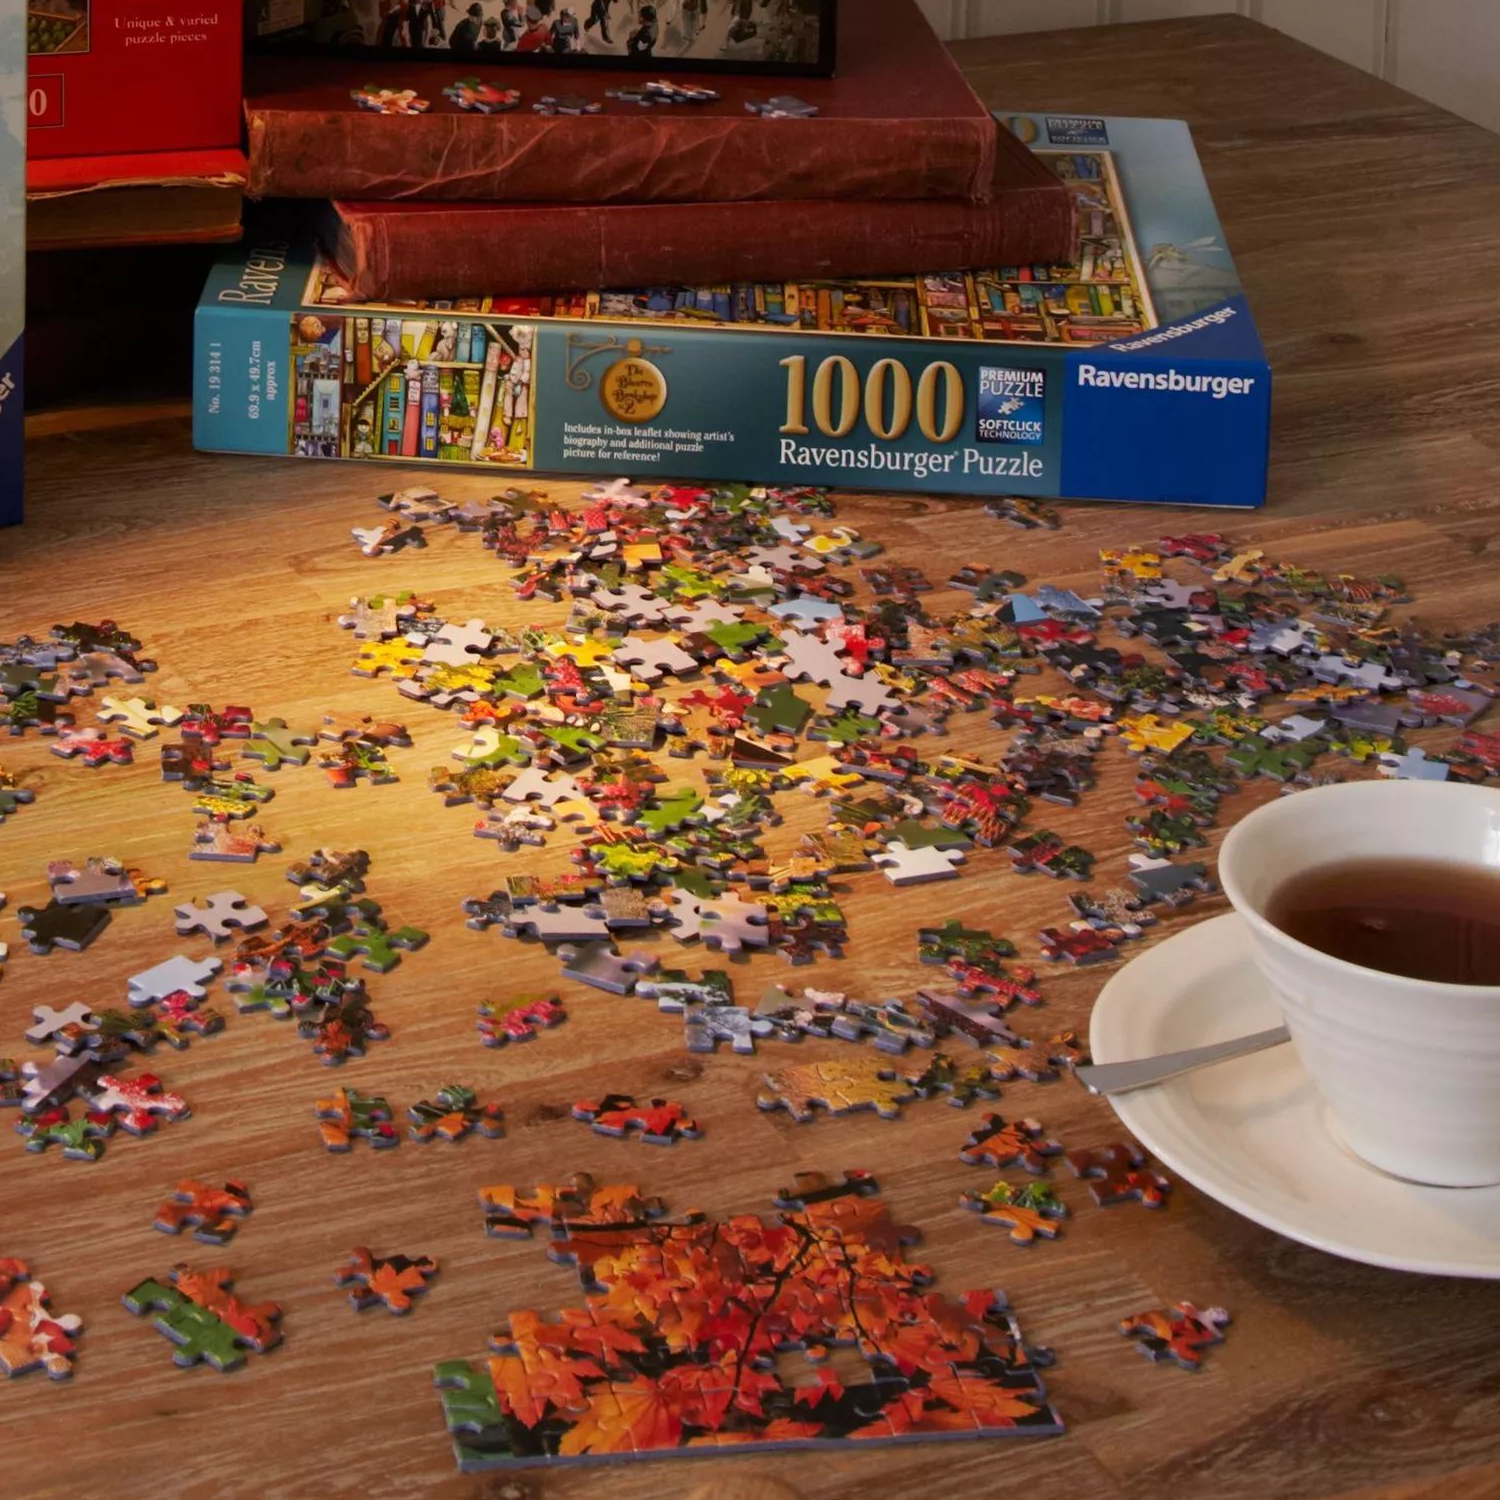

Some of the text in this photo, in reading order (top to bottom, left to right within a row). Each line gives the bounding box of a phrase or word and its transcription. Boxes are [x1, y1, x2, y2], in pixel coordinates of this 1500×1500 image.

[114, 12, 219, 31] Unique & varied
[124, 31, 208, 47] puzzle pieces
[1108, 306, 1237, 353] Ravensburger
[209, 350, 221, 374] 314
[625, 364, 643, 376] The
[208, 376, 221, 390] 19
[248, 341, 261, 419] 69.9 x 49.7cm
[266, 360, 277, 401] approx
[980, 369, 1044, 383] PREMIUM
[1078, 364, 1254, 399] Ravensburger
[980, 380, 1044, 397] PUZZLE
[208, 394, 221, 415] No.
[779, 355, 965, 443] 1000
[564, 422, 735, 442] Includes in-box leaflet showing artist's
[979, 418, 1042, 432] SOFTCLICK
[979, 429, 1042, 440] TECHNOLOGY
[563, 435, 704, 453] biography and additional puzzle
[563, 448, 660, 462] picture for reference!
[779, 438, 1044, 478] Ravensburger Puzzle
